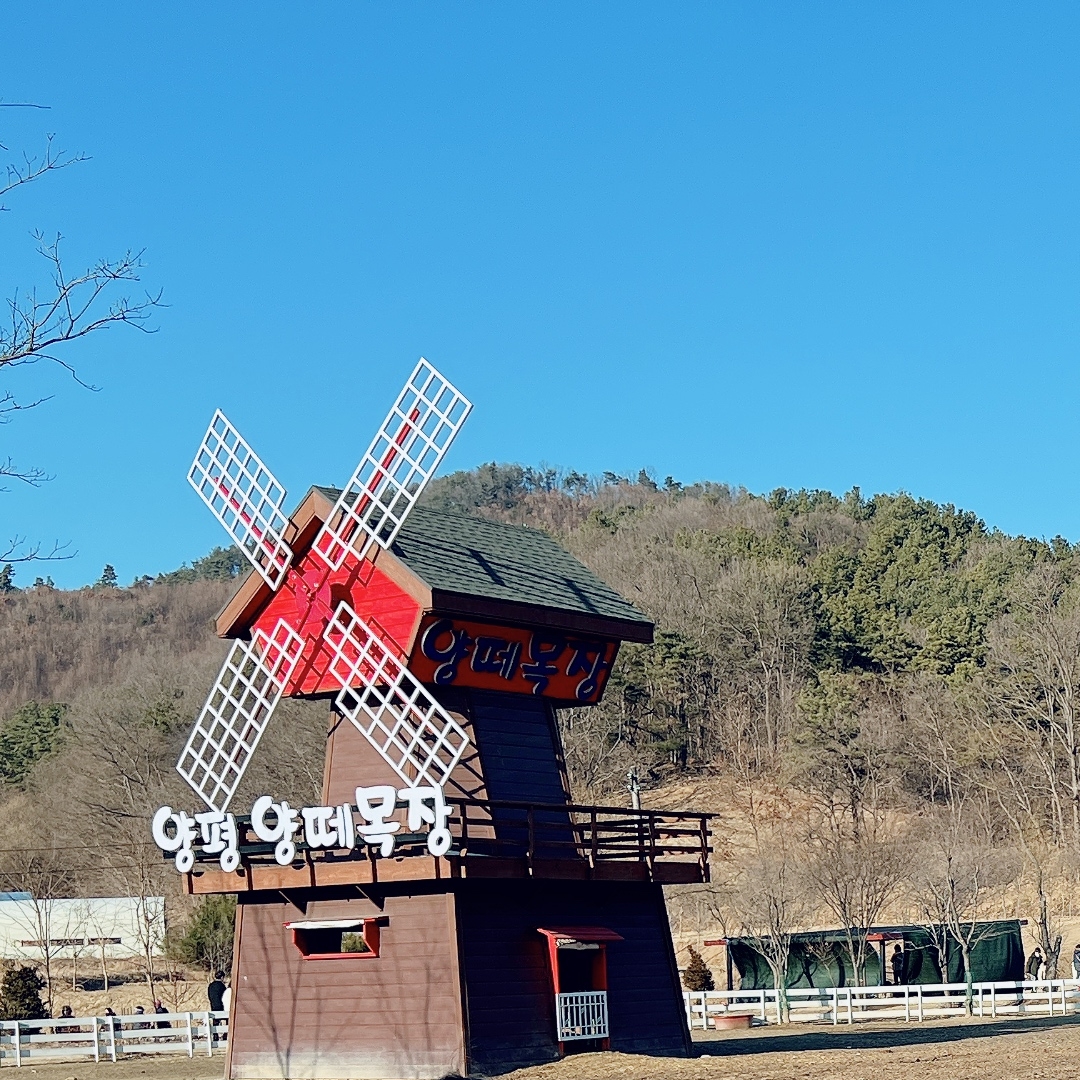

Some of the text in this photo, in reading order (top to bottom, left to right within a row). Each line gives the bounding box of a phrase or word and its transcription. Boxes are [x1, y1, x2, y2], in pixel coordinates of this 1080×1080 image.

[420, 618, 608, 701] 양떼목장
[152, 785, 455, 873] 양평 양떼목장
